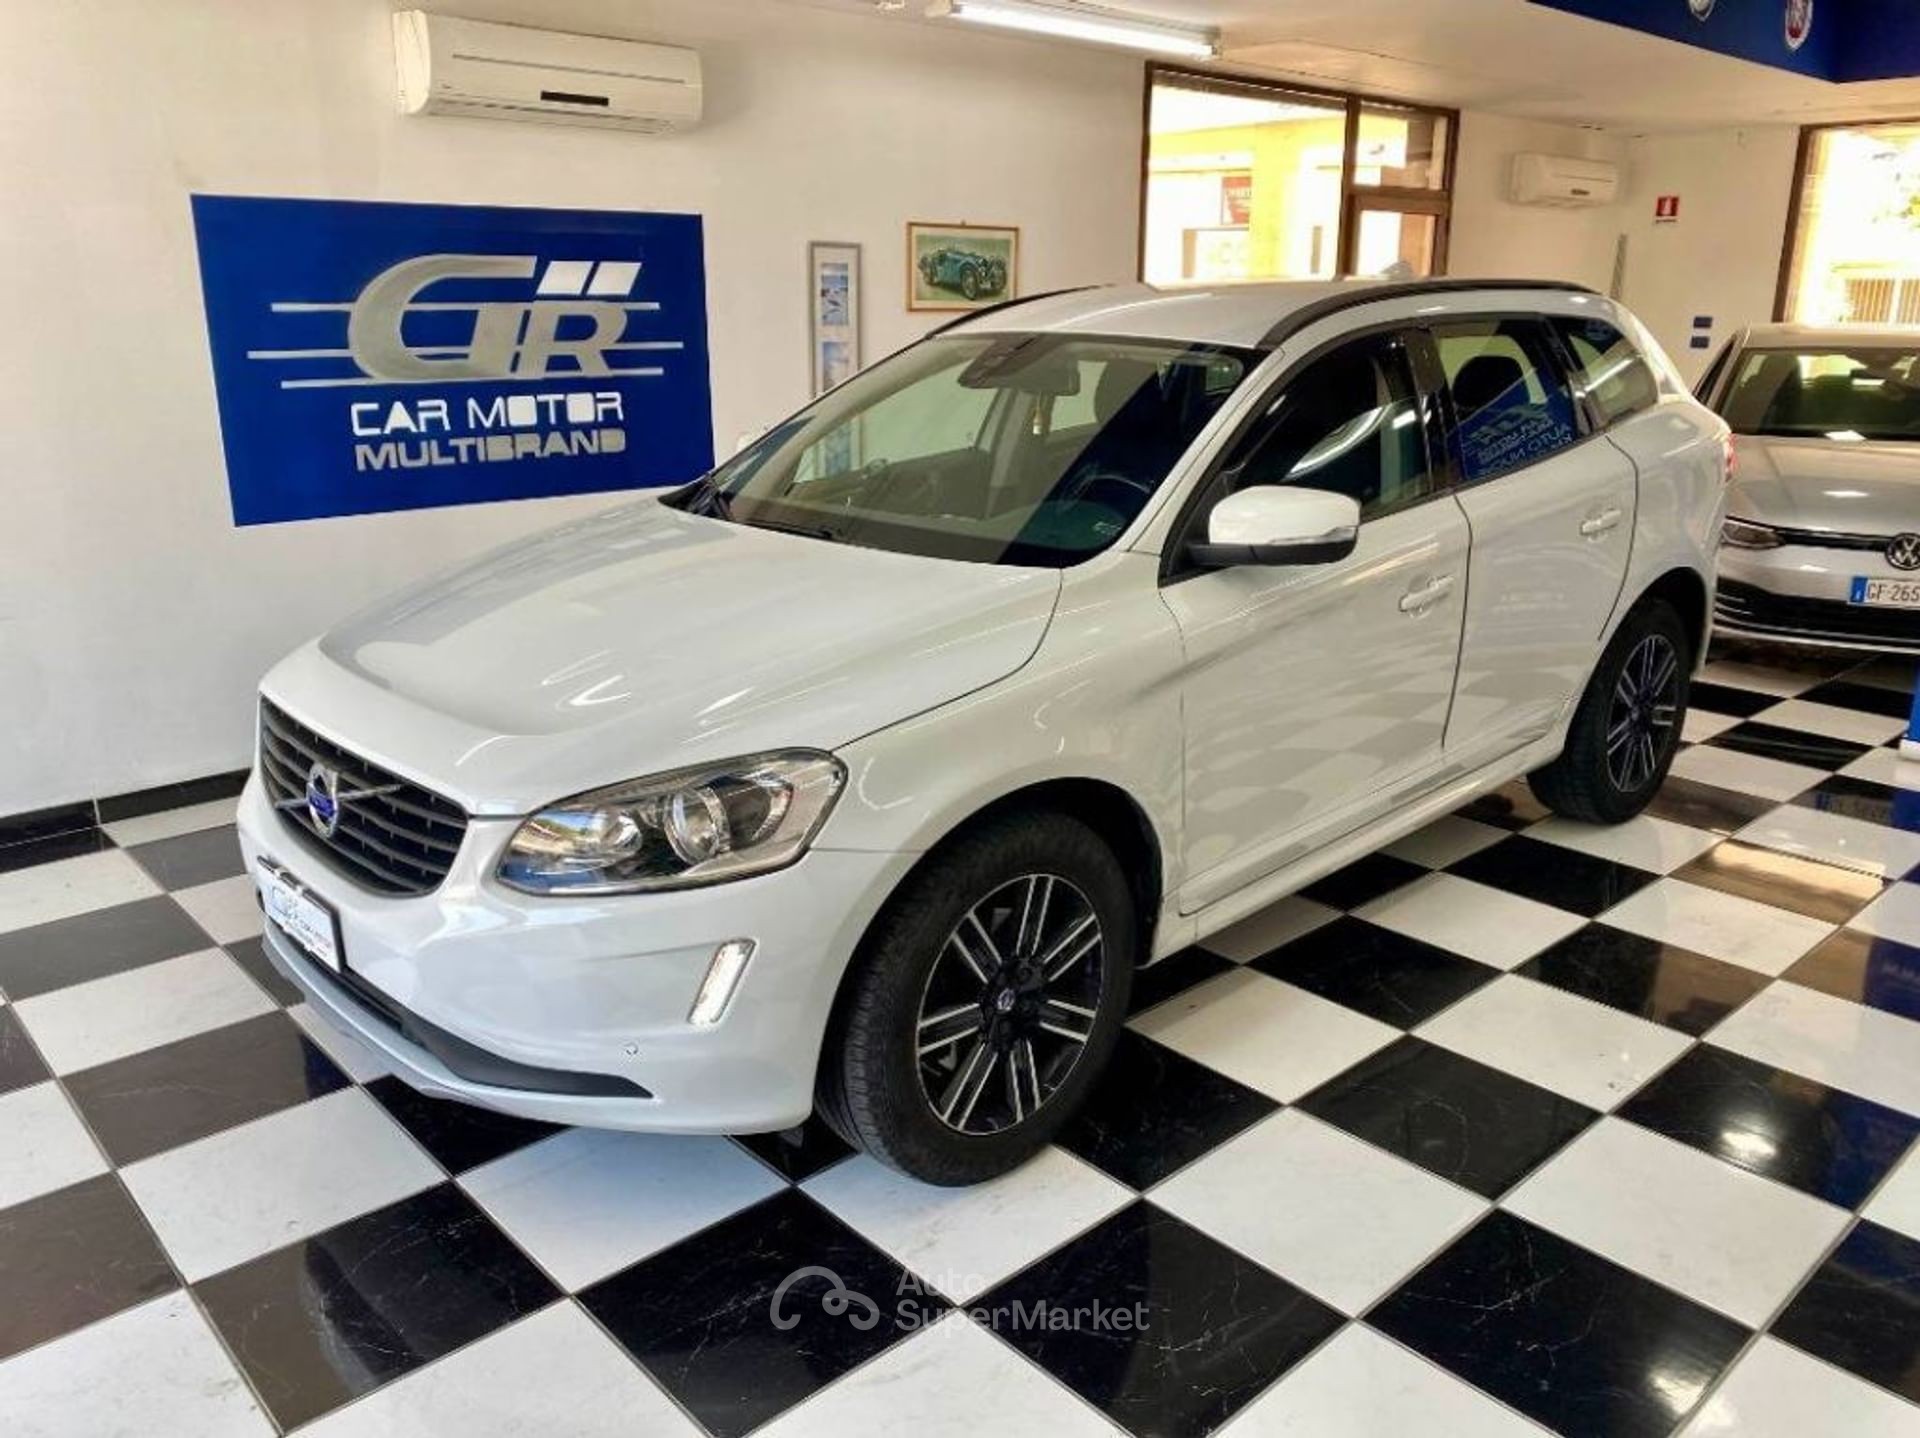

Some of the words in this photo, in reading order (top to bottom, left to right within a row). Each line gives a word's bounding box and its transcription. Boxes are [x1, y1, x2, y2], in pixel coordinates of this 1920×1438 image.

[350, 400, 451, 436] CAR
[468, 391, 624, 429] MOTOR
[355, 429, 627, 471] MULTIBRAND
